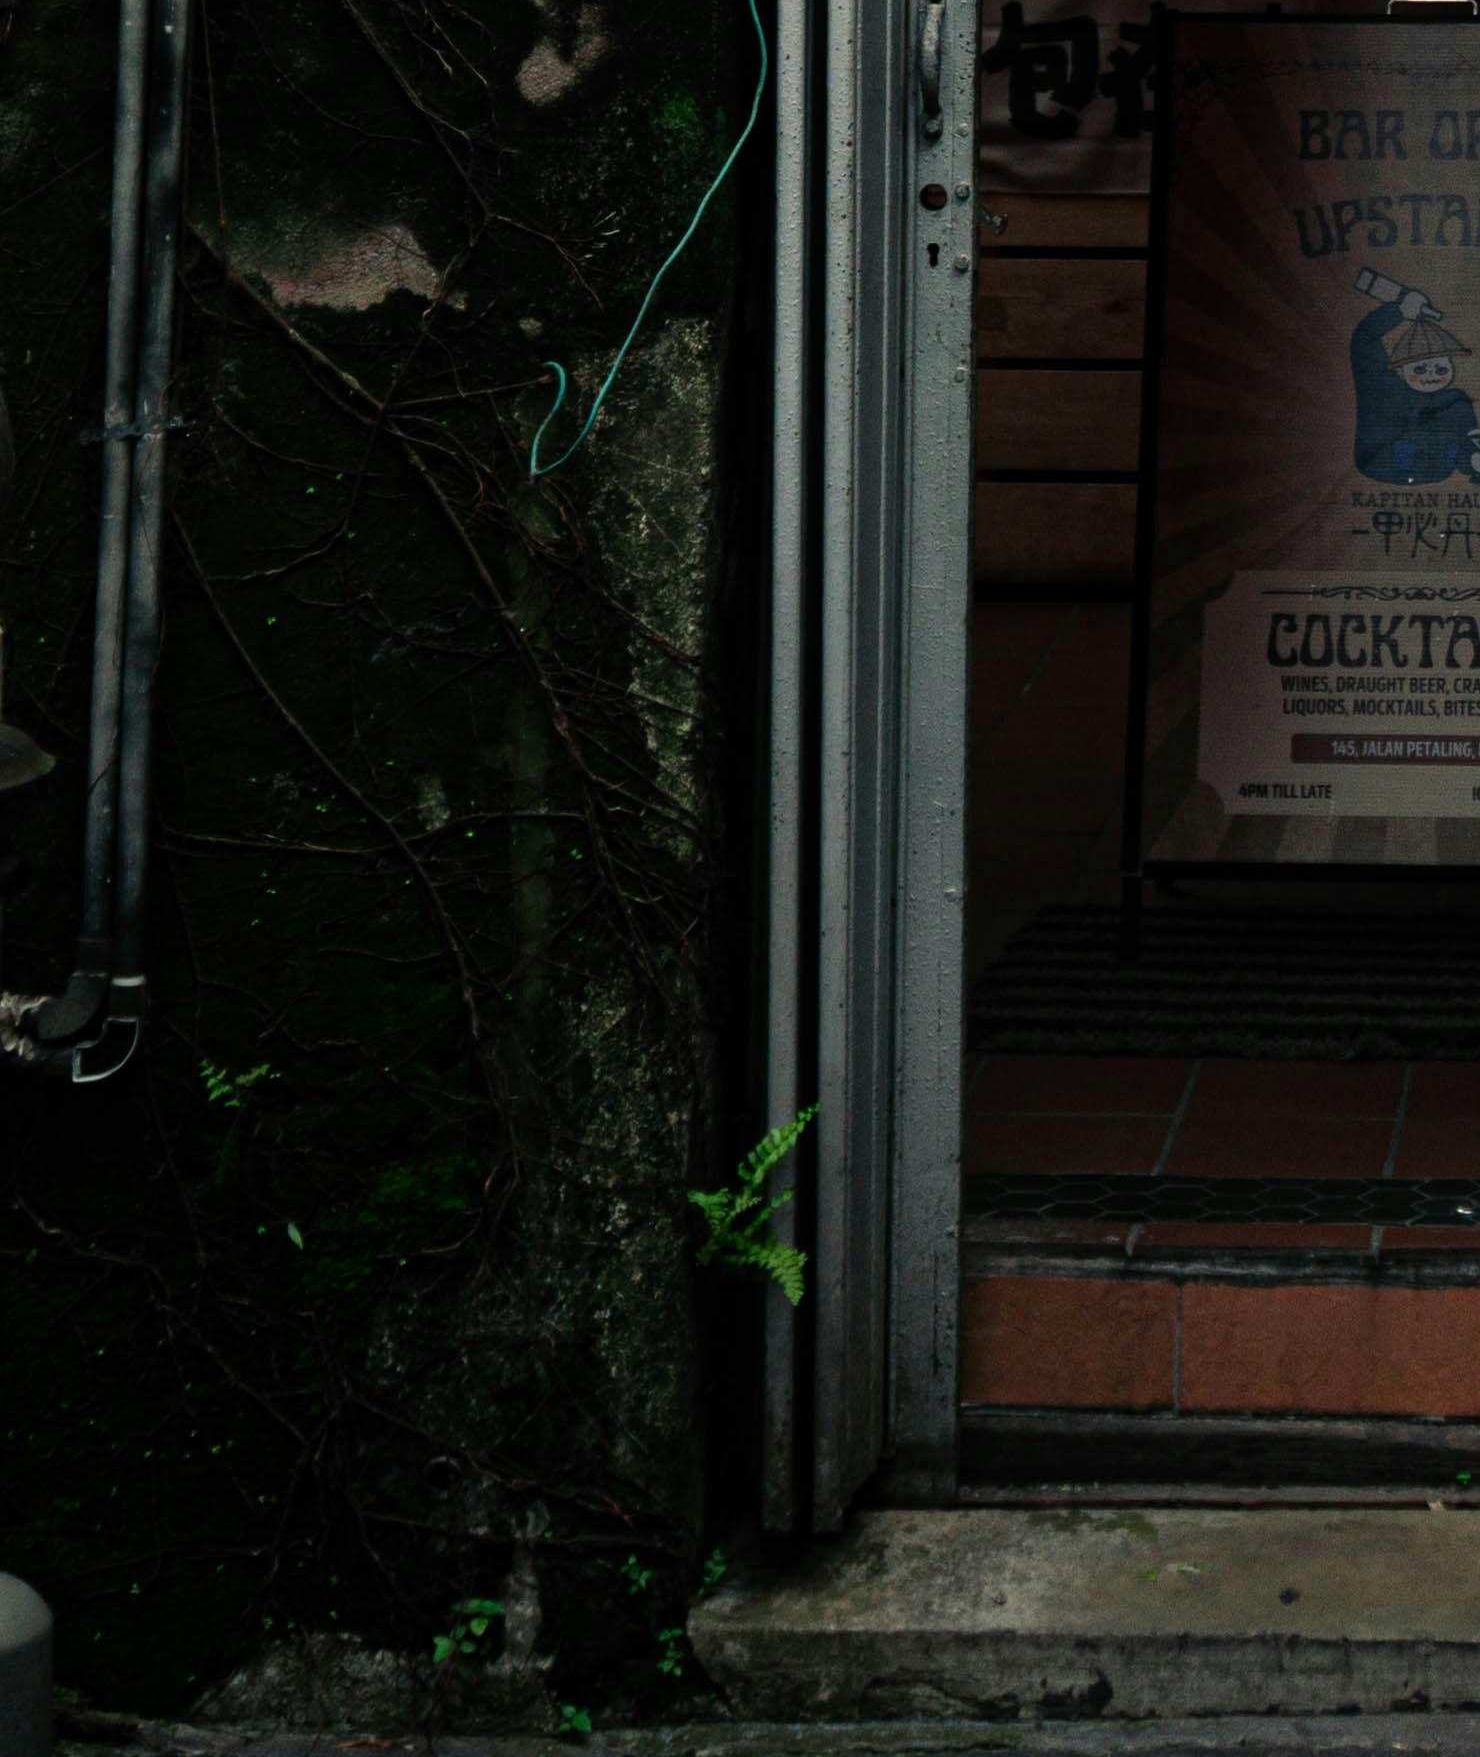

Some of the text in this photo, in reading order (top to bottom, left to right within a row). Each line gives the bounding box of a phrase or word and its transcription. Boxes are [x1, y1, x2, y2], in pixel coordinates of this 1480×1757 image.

[1299, 110, 1407, 160] BAR
[1351, 492, 1439, 508] KAPITAN
[1281, 676, 1333, 694] WINES,
[1336, 676, 1405, 693] DRAUGHT
[1409, 677, 1450, 695] BEER,
[1282, 698, 1349, 717] LIQUORS,
[1353, 699, 1441, 718] MOCKTAILS,
[1331, 740, 1359, 759] 145,
[1361, 741, 1404, 757] JALAN
[1406, 741, 1476, 759] PETALING,
[1238, 784, 1332, 799] 4PM TILL LATE
